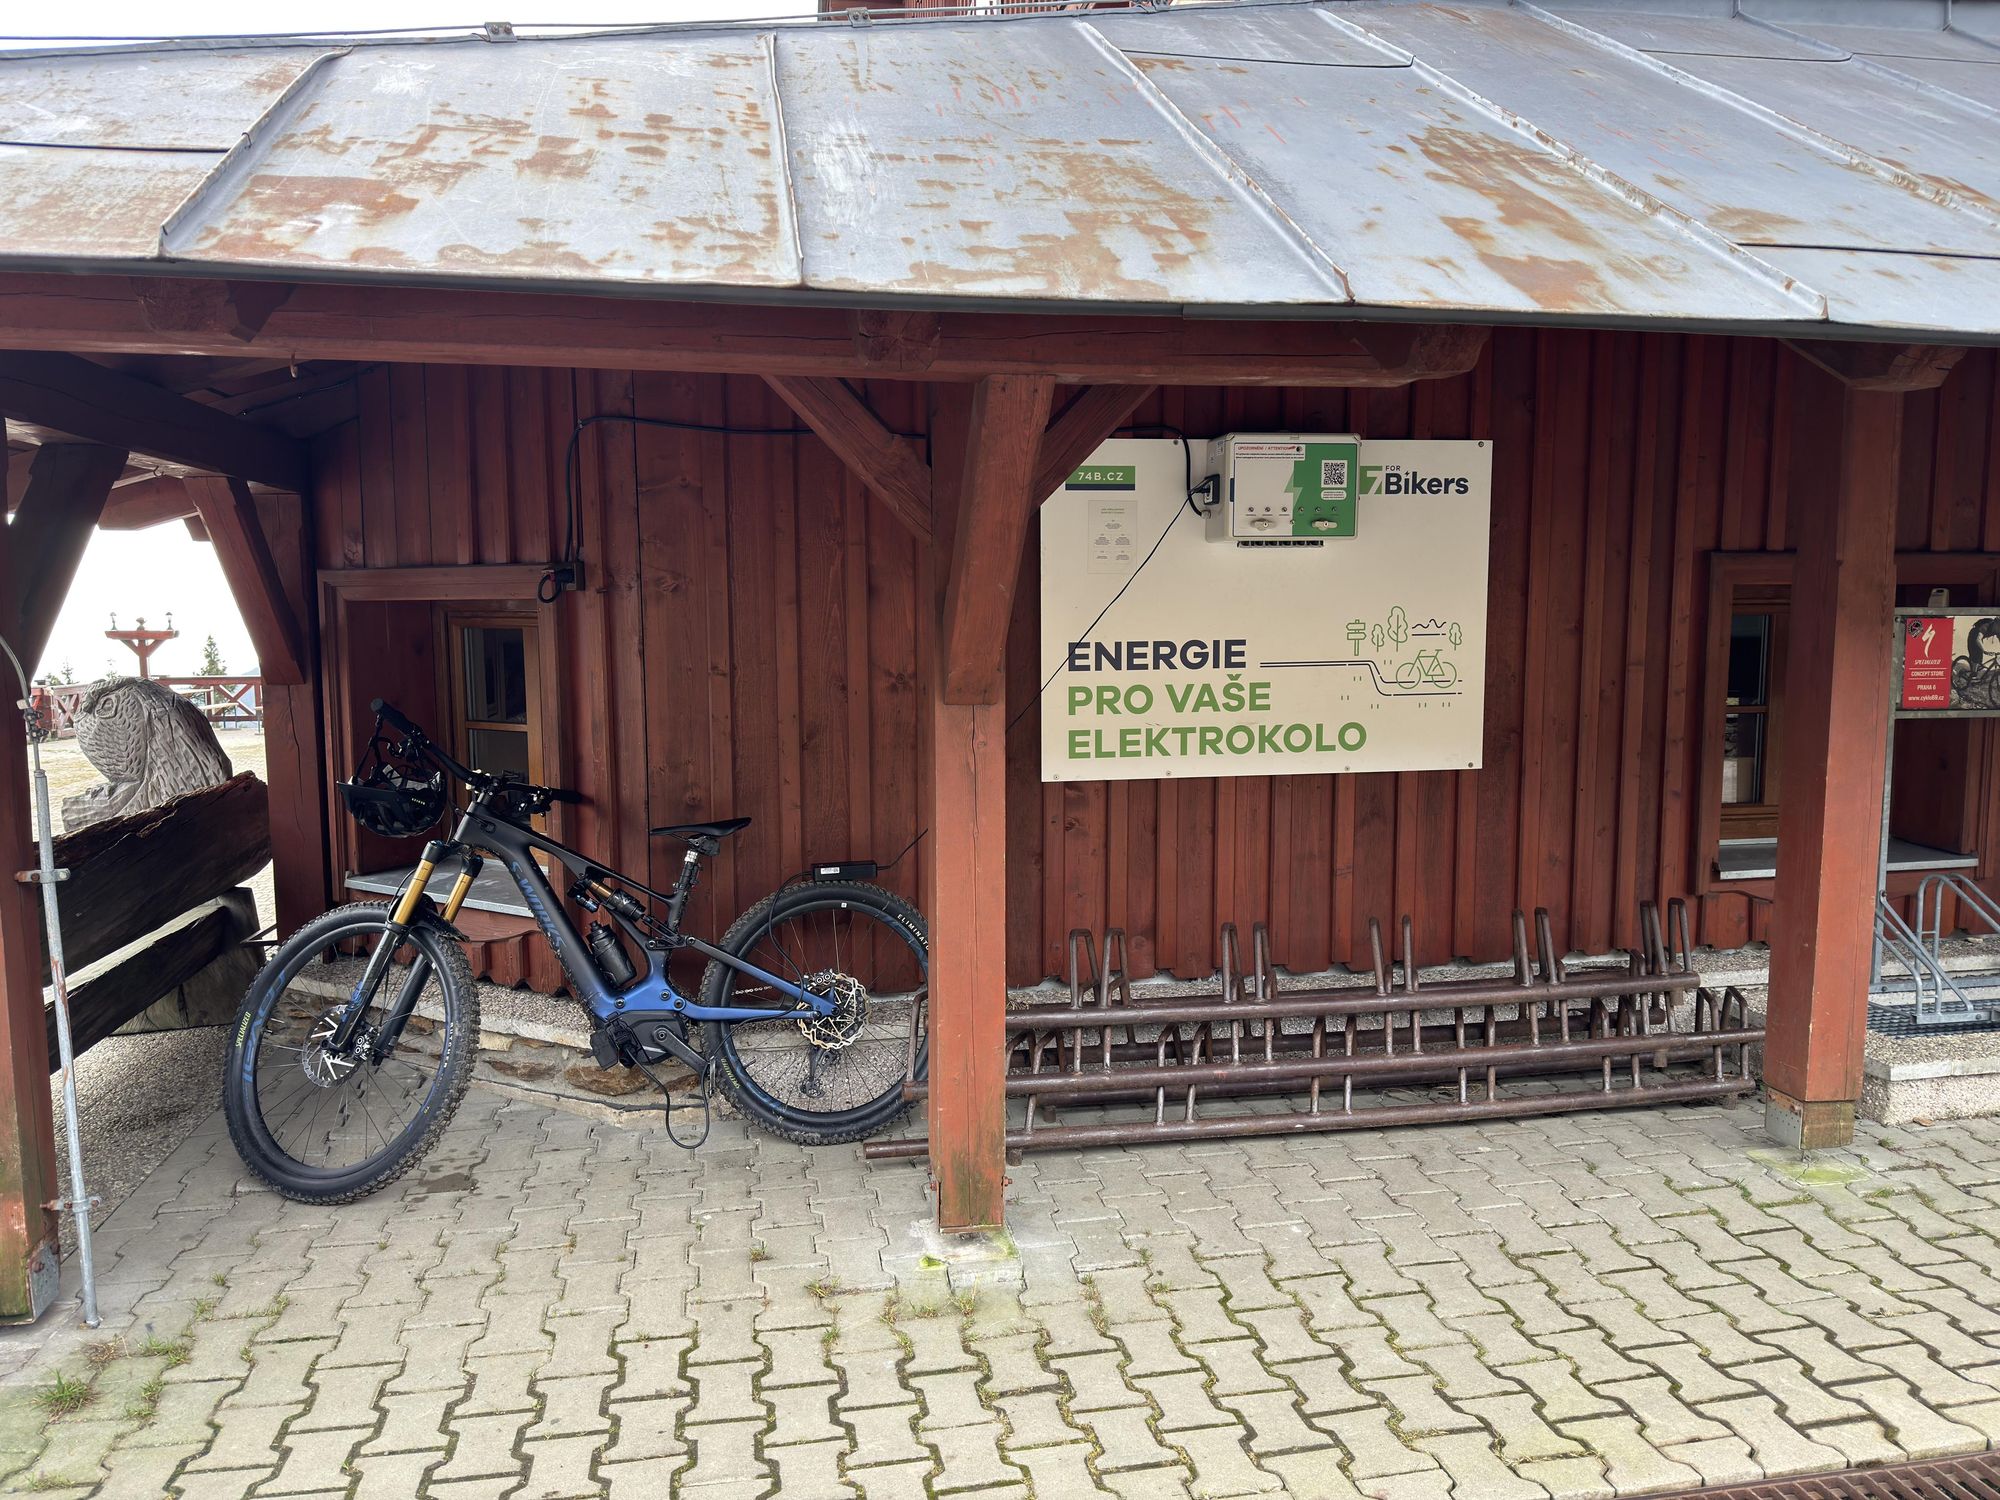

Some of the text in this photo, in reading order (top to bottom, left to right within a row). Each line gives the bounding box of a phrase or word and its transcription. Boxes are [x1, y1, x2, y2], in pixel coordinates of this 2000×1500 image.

[1078, 471, 1124, 481] 74B.CZ
[1385, 470, 1469, 495] Bikers
[1068, 639, 1247, 672] ENERGIE
[1068, 673, 1271, 716] PRO VAŠE
[1068, 721, 1367, 759] ELEKTROKOLO
